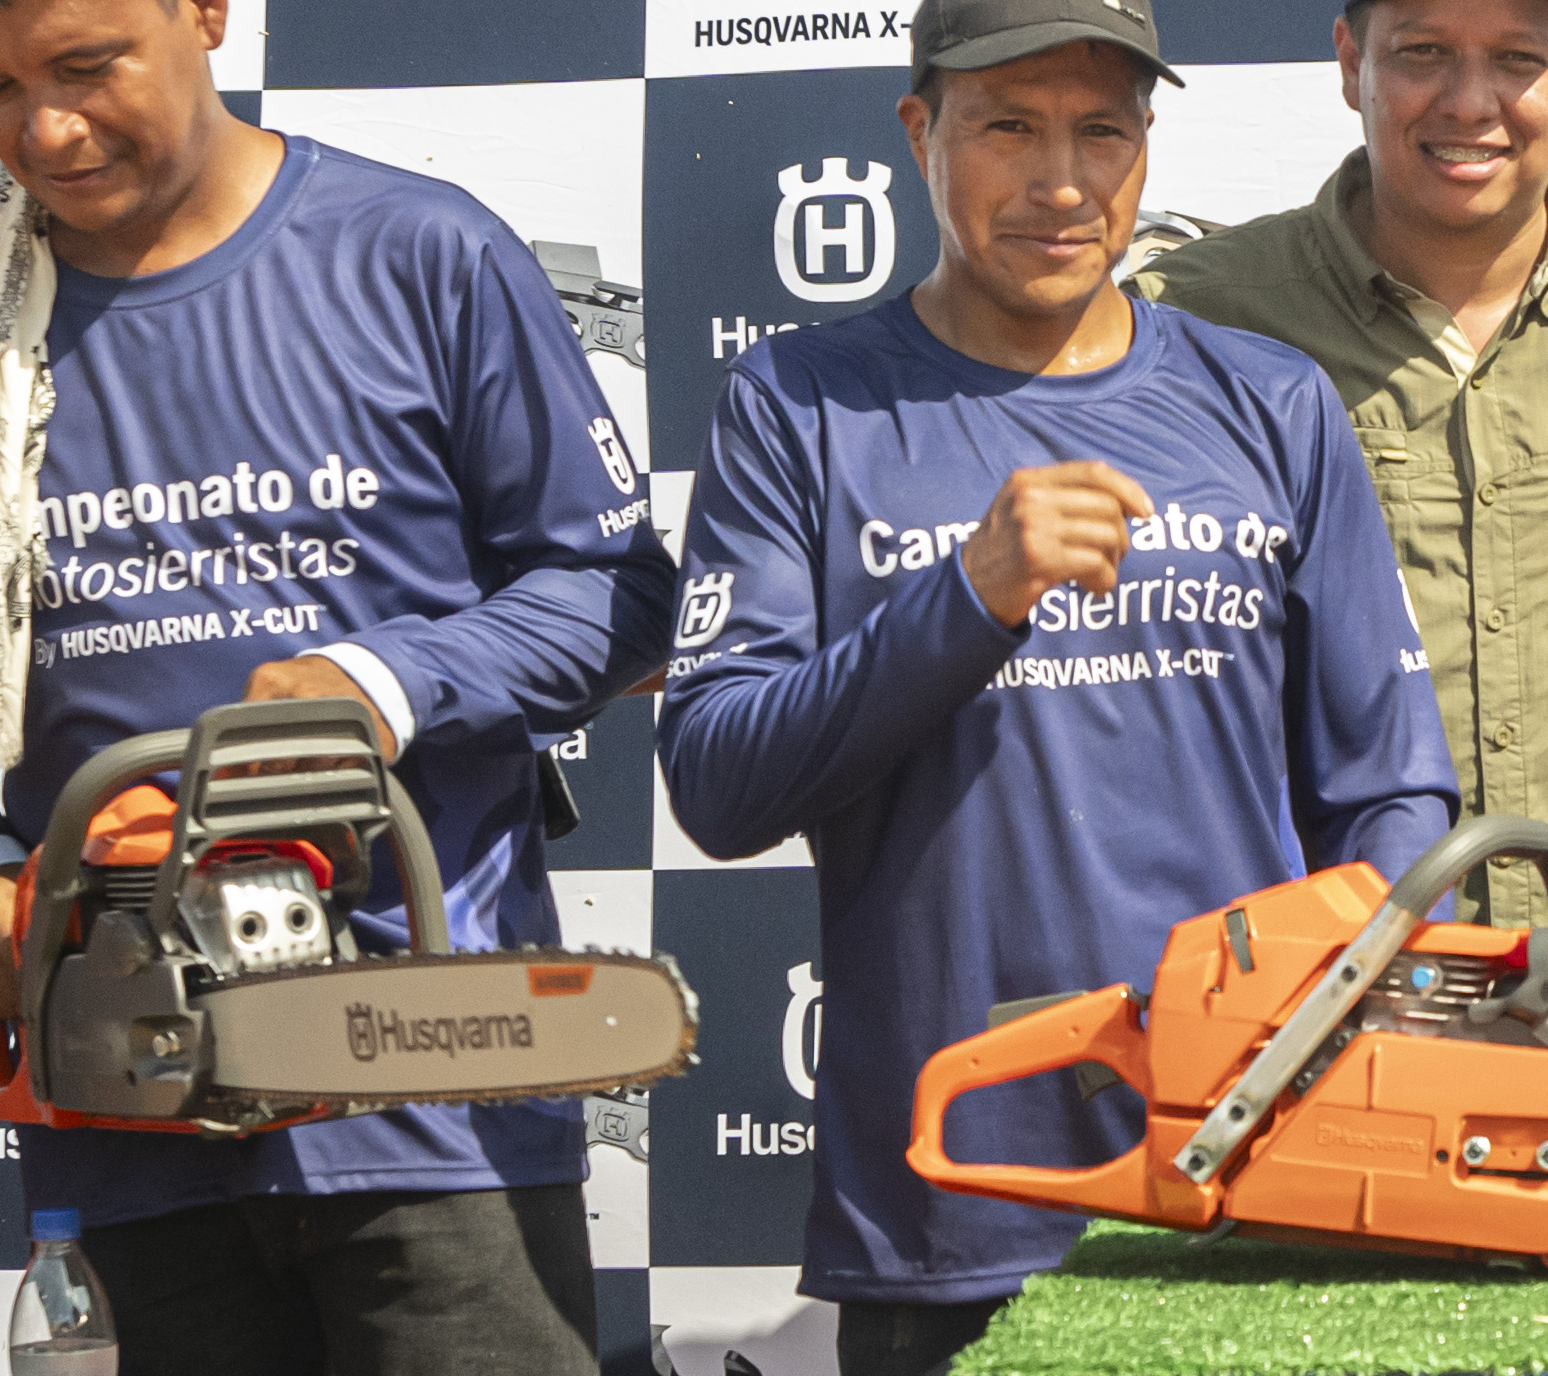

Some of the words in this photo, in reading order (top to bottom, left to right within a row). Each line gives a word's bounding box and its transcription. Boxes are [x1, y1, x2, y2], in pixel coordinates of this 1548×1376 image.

[694, 13, 872, 49] HUSQVARNA
[308, 452, 379, 511] de
[61, 615, 224, 660] HUSQVARNA
[378, 1008, 533, 1060] Husqvarna
